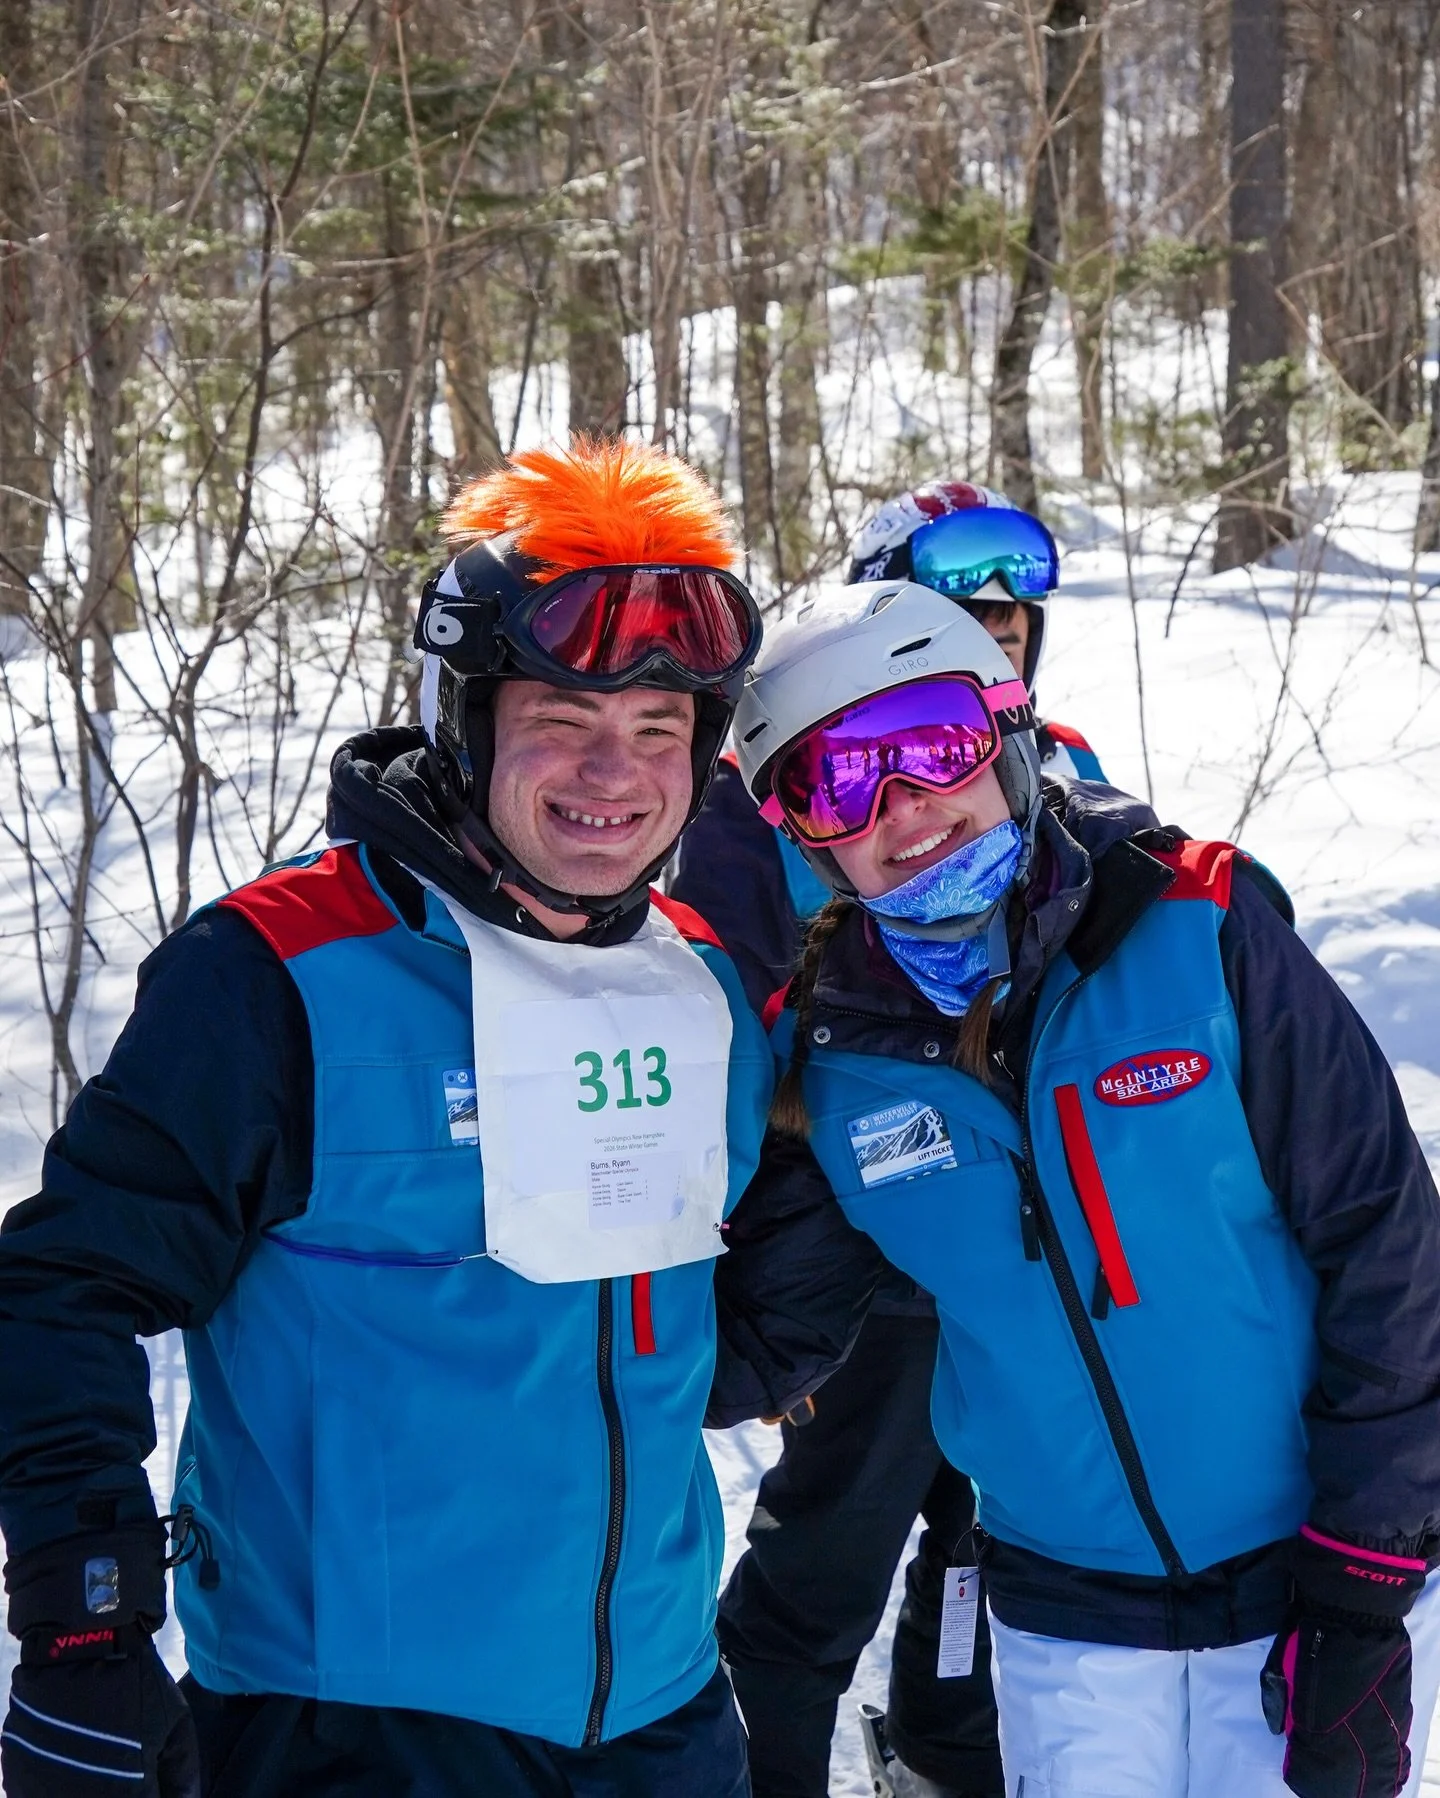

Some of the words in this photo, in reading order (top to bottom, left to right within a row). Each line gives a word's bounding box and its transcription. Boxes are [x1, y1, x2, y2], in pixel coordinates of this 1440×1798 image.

[888, 657, 929, 676] GIRO
[575, 1046, 672, 1112] 313
[1101, 1057, 1200, 1092] McINTYRE
[1117, 1085, 1141, 1098] SKI
[1151, 1073, 1192, 1091] AREA
[872, 1103, 918, 1122] WATERVILLE
[917, 1152, 931, 1161] LIFT
[931, 1145, 953, 1156] TICKET
[1344, 1565, 1406, 1586] SCOTT
